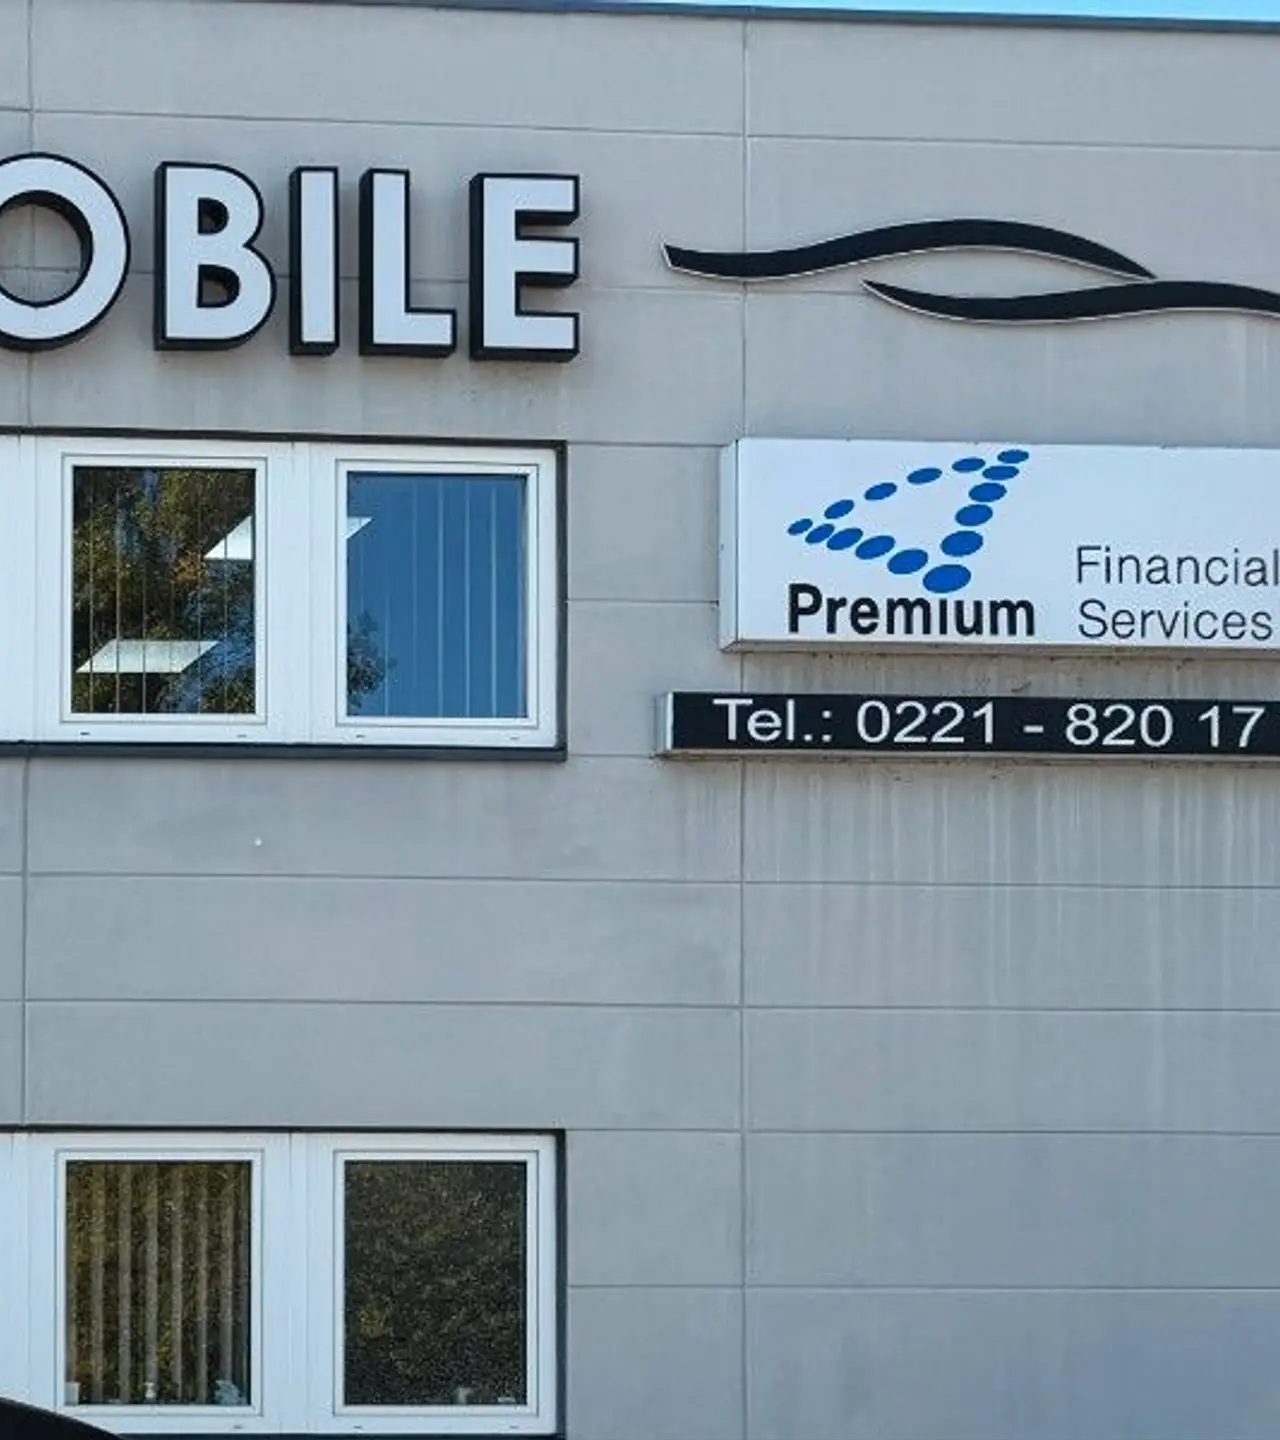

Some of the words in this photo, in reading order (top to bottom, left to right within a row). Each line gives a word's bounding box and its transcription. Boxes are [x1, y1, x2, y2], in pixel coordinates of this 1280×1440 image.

[1075, 543, 1280, 588] Financial
[787, 582, 1036, 637] Premium
[1077, 598, 1274, 641] Services
[712, 697, 833, 744] Tel.:
[856, 701, 996, 746] 0221
[1064, 701, 1174, 748] 820
[1197, 704, 1265, 750] 17
